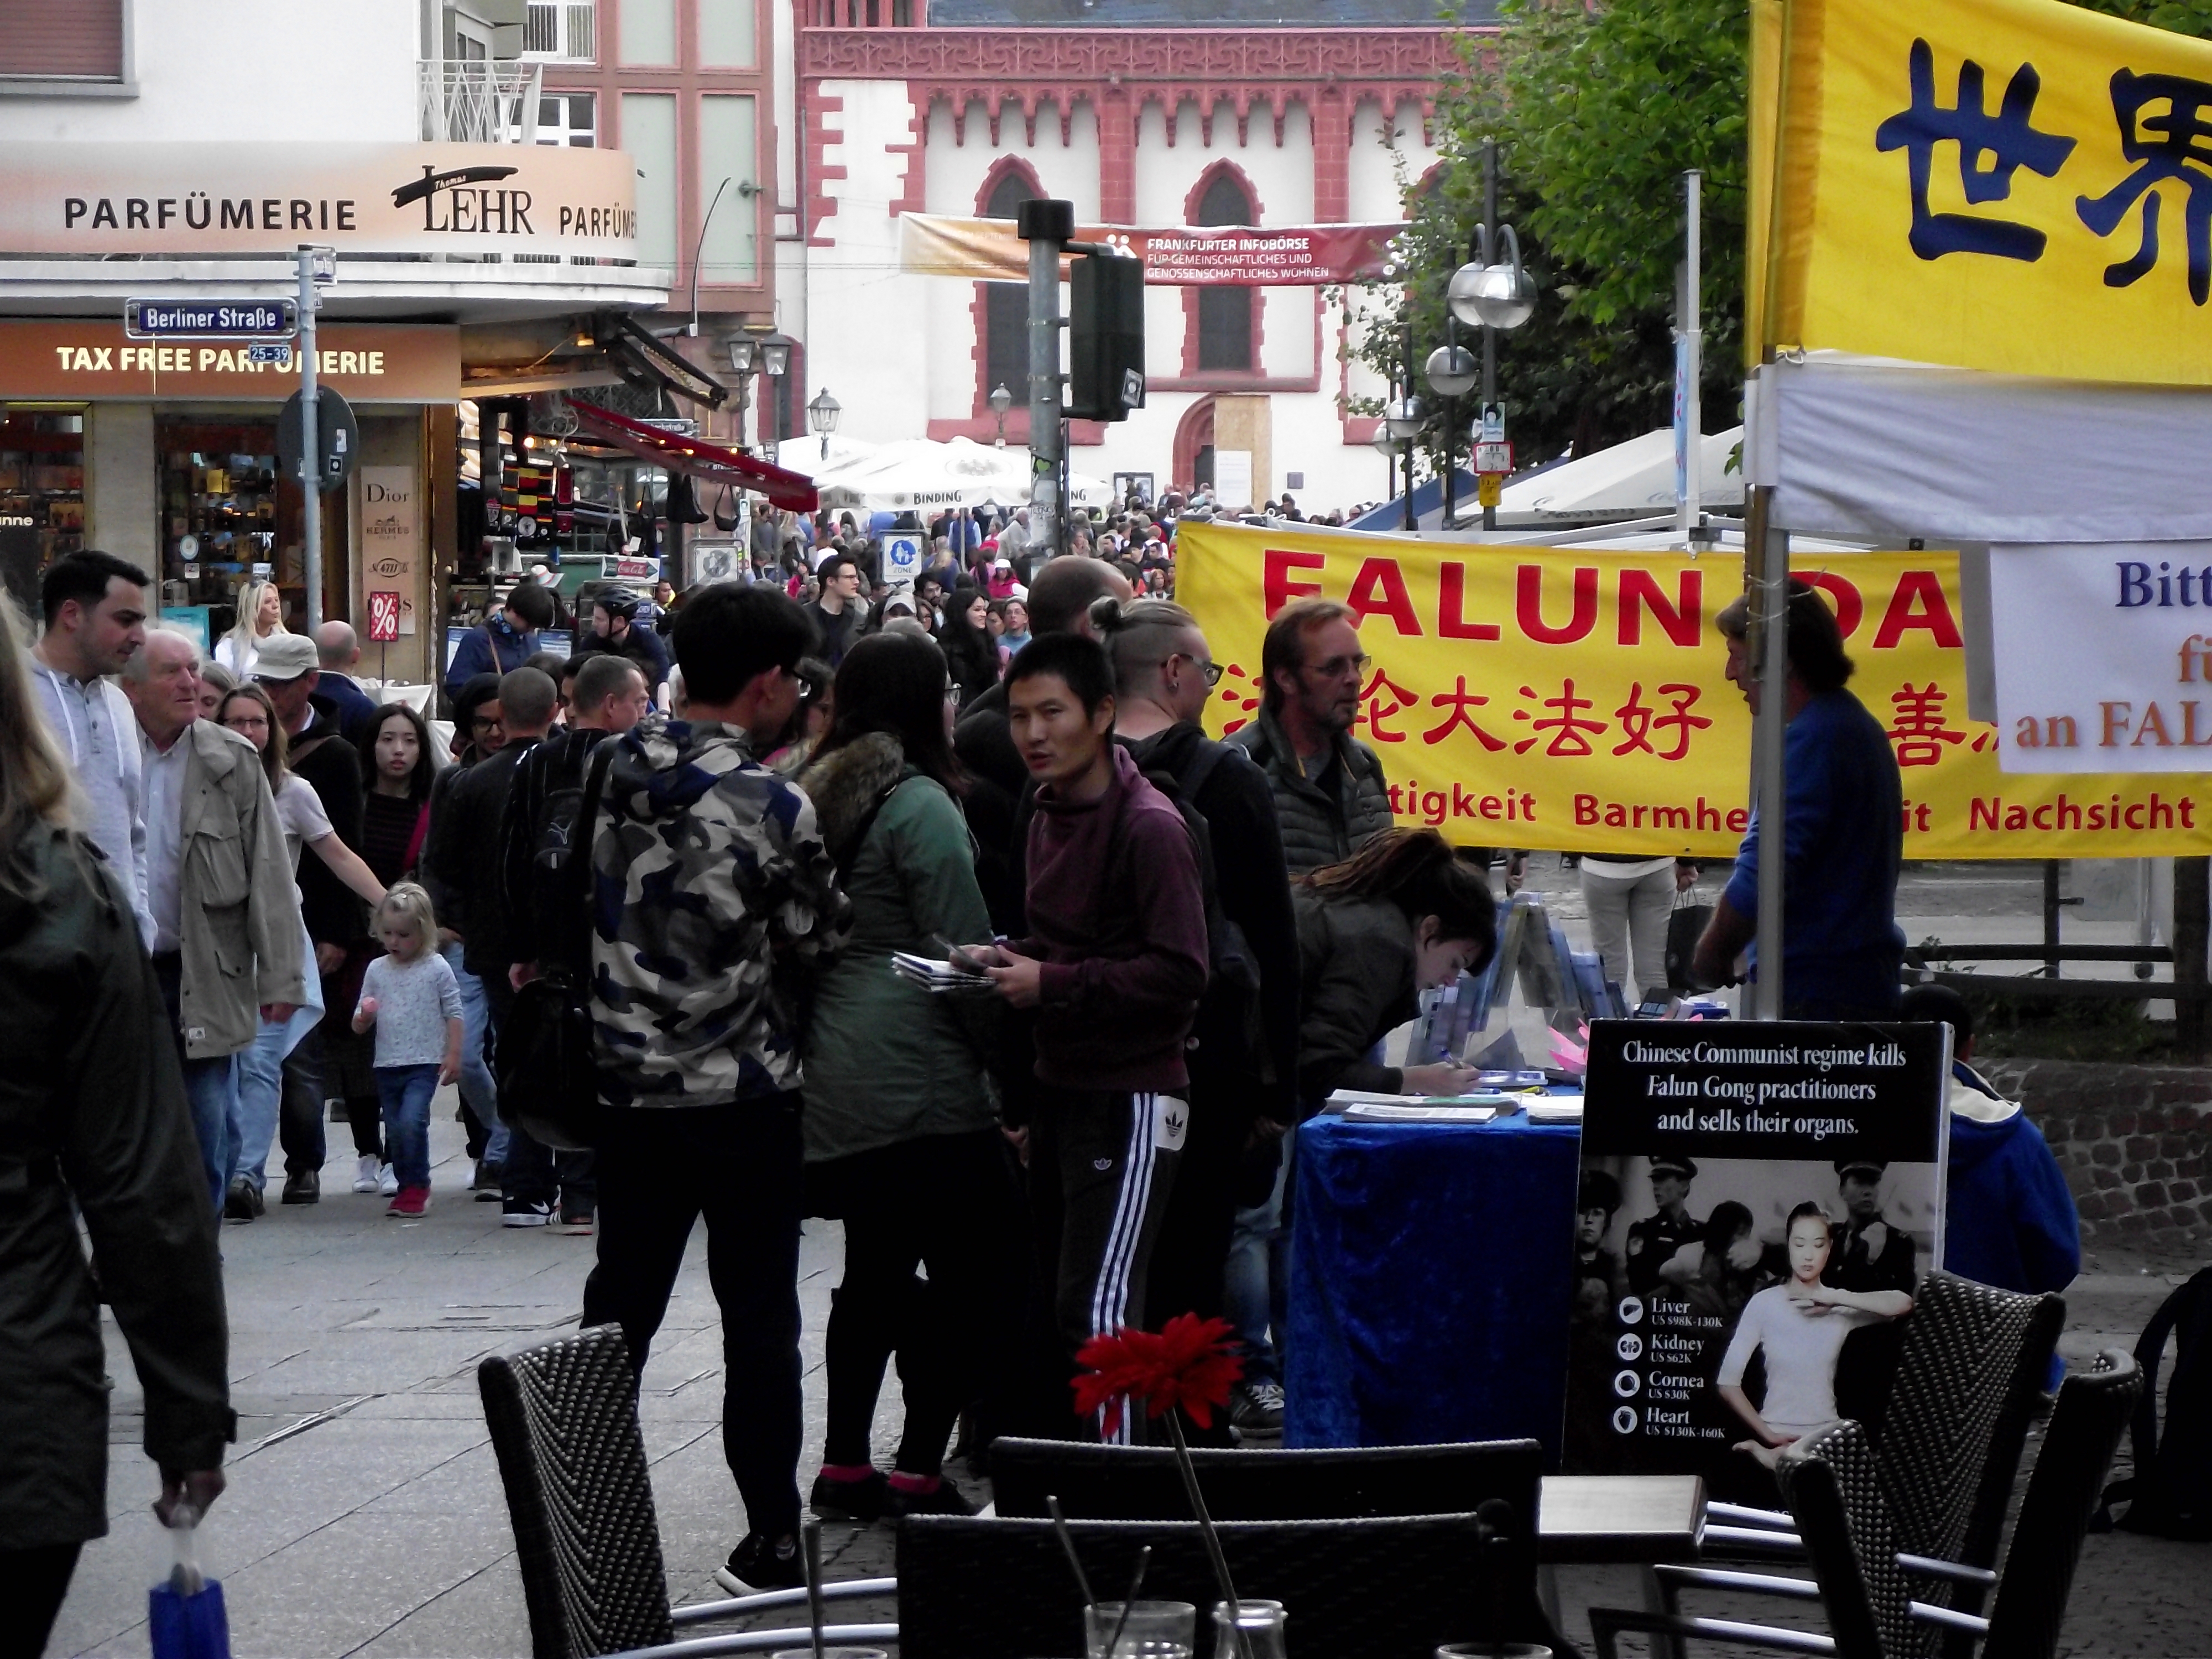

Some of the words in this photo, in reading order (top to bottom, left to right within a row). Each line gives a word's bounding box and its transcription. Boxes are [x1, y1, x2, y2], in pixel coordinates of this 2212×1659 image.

[1876, 37, 2212, 306] 世界
[435, 175, 467, 190] Thomas
[424, 165, 534, 234] LEHR
[65, 191, 356, 231] PARFÜMERIE
[1147, 238, 1237, 251] FRANKFURTER
[1240, 236, 1309, 249] INFOBÖRSE
[1171, 254, 1286, 265] GEMEINSCHAFTLICHES
[1289, 253, 1312, 264] UND
[1147, 268, 1278, 279] GENOSSENSCHAFTLICHES
[1281, 267, 1329, 278] WOHNEN
[147, 308, 213, 328] Berliner
[220, 307, 276, 330] Straße
[56, 347, 113, 371] TAX
[121, 348, 191, 372] FREE
[251, 347, 289, 361] 25-39
[367, 483, 409, 503] Dior
[914, 489, 962, 504] BINDING
[1264, 549, 1702, 647] FALUN
[374, 597, 395, 635] %
[2016, 716, 2078, 747] an
[1387, 781, 1536, 825] tigkeit
[1969, 793, 2195, 832] Nachsicht
[1623, 1041, 1692, 1063] Chinese
[1694, 1041, 1799, 1065] Communist
[1803, 1044, 1865, 1072] regime
[1868, 1044, 1906, 1066] kills
[1647, 1074, 1698, 1097] Falun
[1704, 1076, 1755, 1105] Gong
[1759, 1078, 1876, 1105] practitioners
[1658, 1108, 1694, 1130] and
[1699, 1109, 1740, 1132] sells
[1745, 1110, 1790, 1133] their
[1794, 1118, 1859, 1141] organs.
[1652, 1297, 1691, 1314] Liver
[1652, 1316, 1666, 1326] US
[1652, 1334, 1705, 1355] Kidney
[1651, 1352, 1665, 1363] US
[1648, 1370, 1704, 1388] Cornea
[1648, 1388, 1662, 1399] US
[1646, 1407, 1689, 1425] Heart
[1646, 1425, 1660, 1436] US
